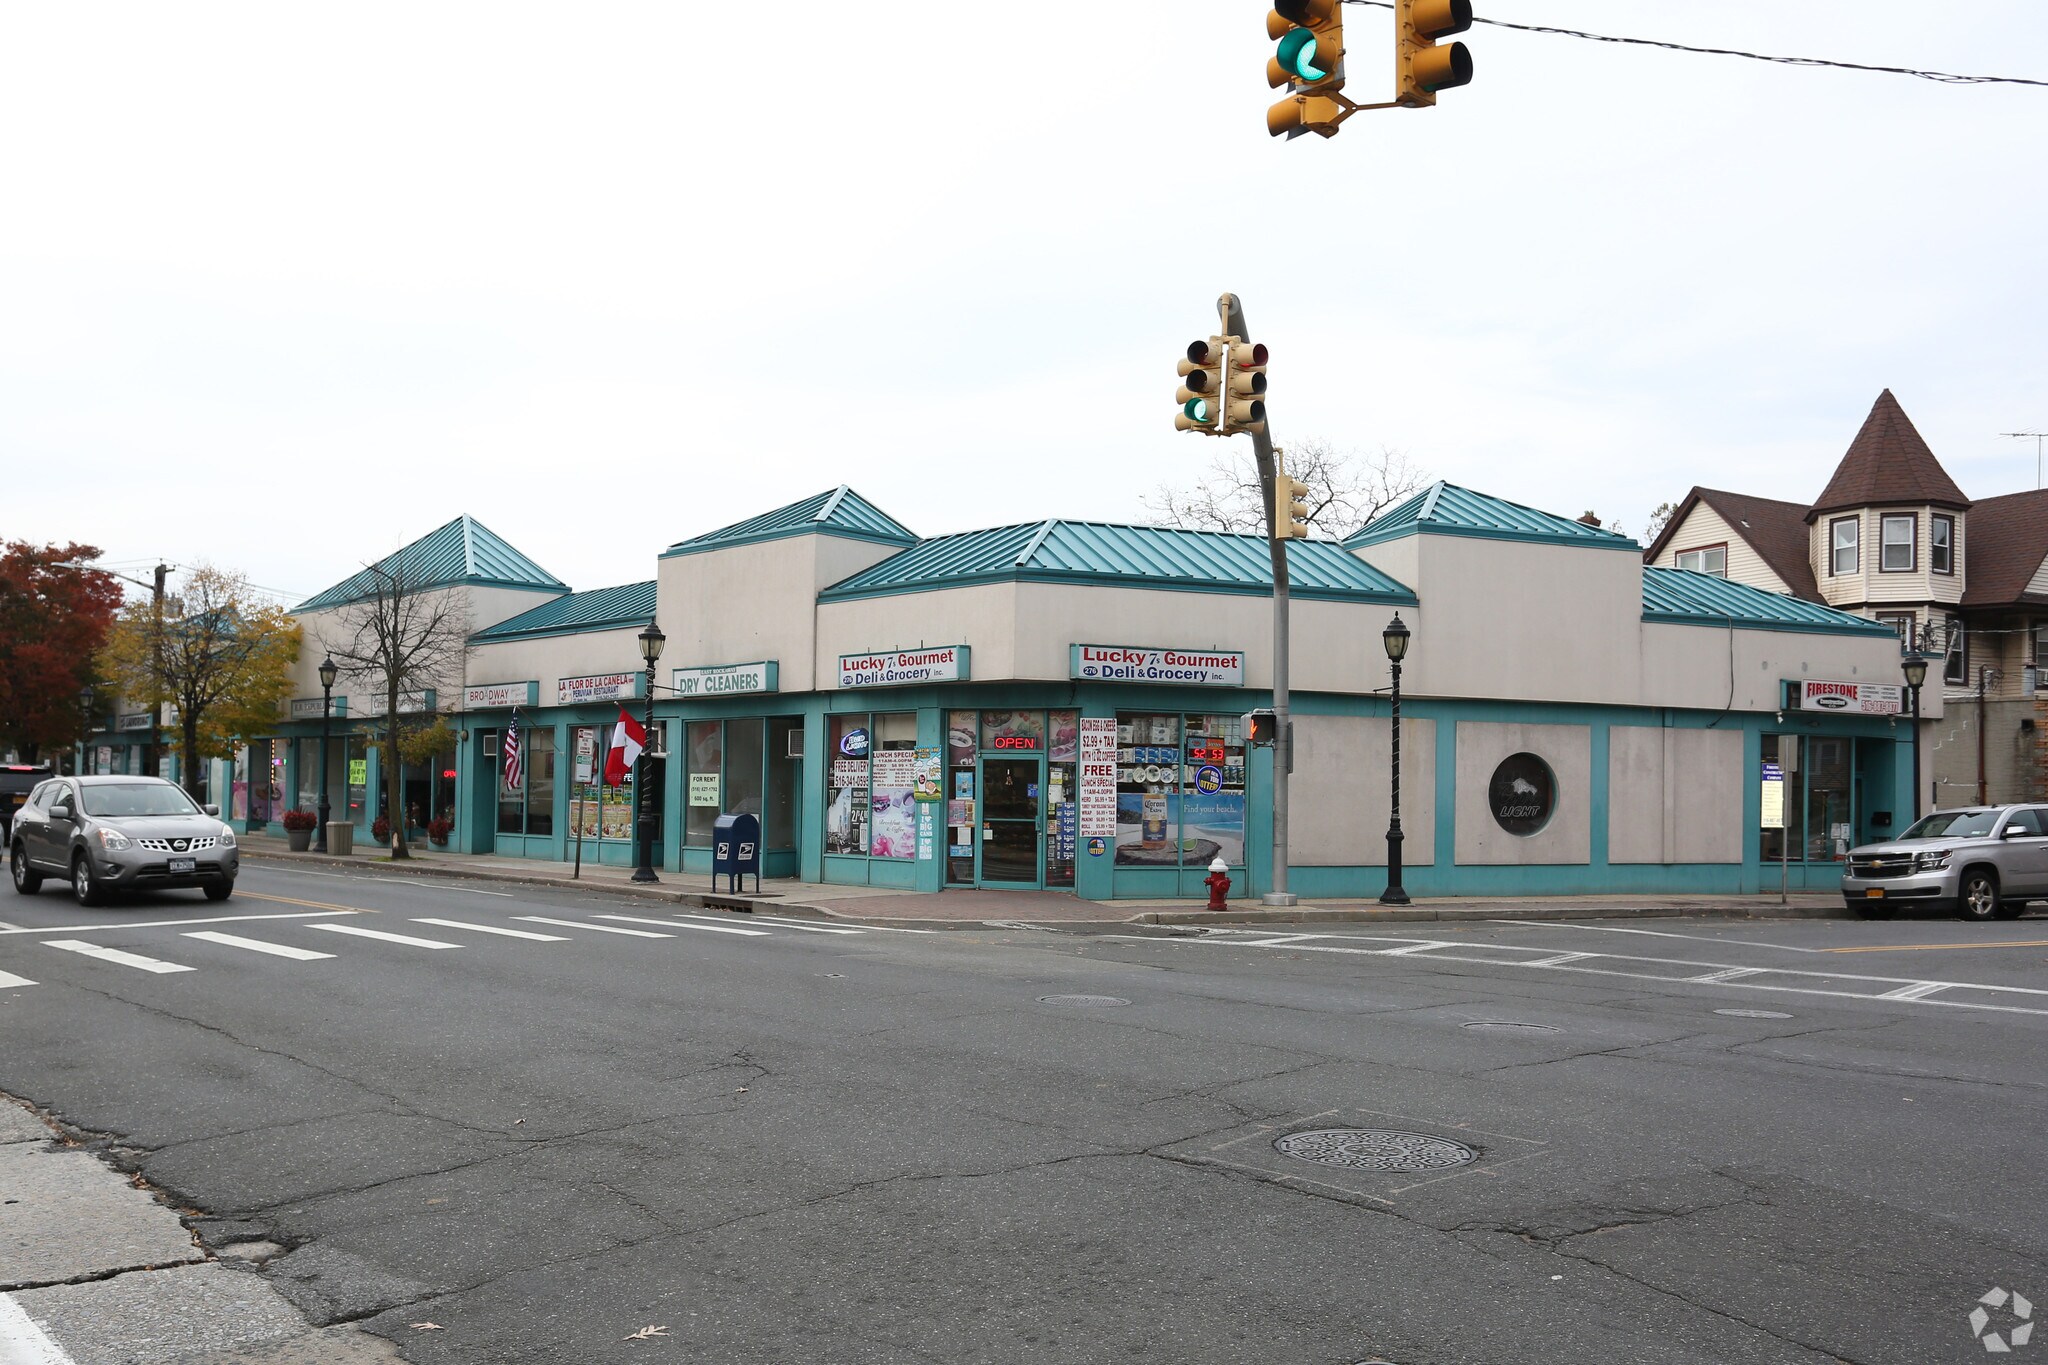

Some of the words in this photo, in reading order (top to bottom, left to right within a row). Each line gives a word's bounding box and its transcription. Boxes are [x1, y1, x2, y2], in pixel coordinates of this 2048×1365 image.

[843, 657, 886, 671] Lucky
[898, 650, 953, 667] Gourmet
[1083, 648, 1146, 666] Lucky
[1164, 651, 1238, 669] Gourmet
[856, 671, 878, 684] Deli
[880, 674, 885, 682] &
[886, 668, 931, 681] Grocery
[1102, 665, 1135, 678] Deli
[1138, 668, 1145, 678] &
[1147, 666, 1208, 682] Grocery
[559, 681, 566, 691] LA
[569, 679, 584, 690] FLOR
[585, 679, 593, 688] DE
[595, 678, 602, 687] LA
[604, 674, 628, 686] CANELA
[679, 678, 699, 693] DRY
[705, 673, 758, 692] CLEANERS
[573, 688, 592, 698] PERUVIAN
[594, 685, 619, 695] RESTAURANT
[1807, 682, 1858, 700] FIRESTONE
[995, 738, 1034, 749] OPEN
[1083, 735, 1097, 747] $2.99
[1104, 736, 1114, 747] TAX
[1102, 751, 1115, 761] COFFEE
[1194, 748, 1206, 758] 52
[1212, 749, 1224, 760] 53
[835, 761, 847, 773] FREE
[1084, 765, 1112, 776] FREE
[1081, 778, 1096, 787] LUNCH
[1097, 778, 1115, 787] SPECIAL
[1145, 800, 1166, 808] Corona
[1184, 804, 1199, 813] Find
[1200, 806, 1216, 817] your
[1500, 806, 1540, 818] LIGHT
[920, 823, 933, 831] BIG
